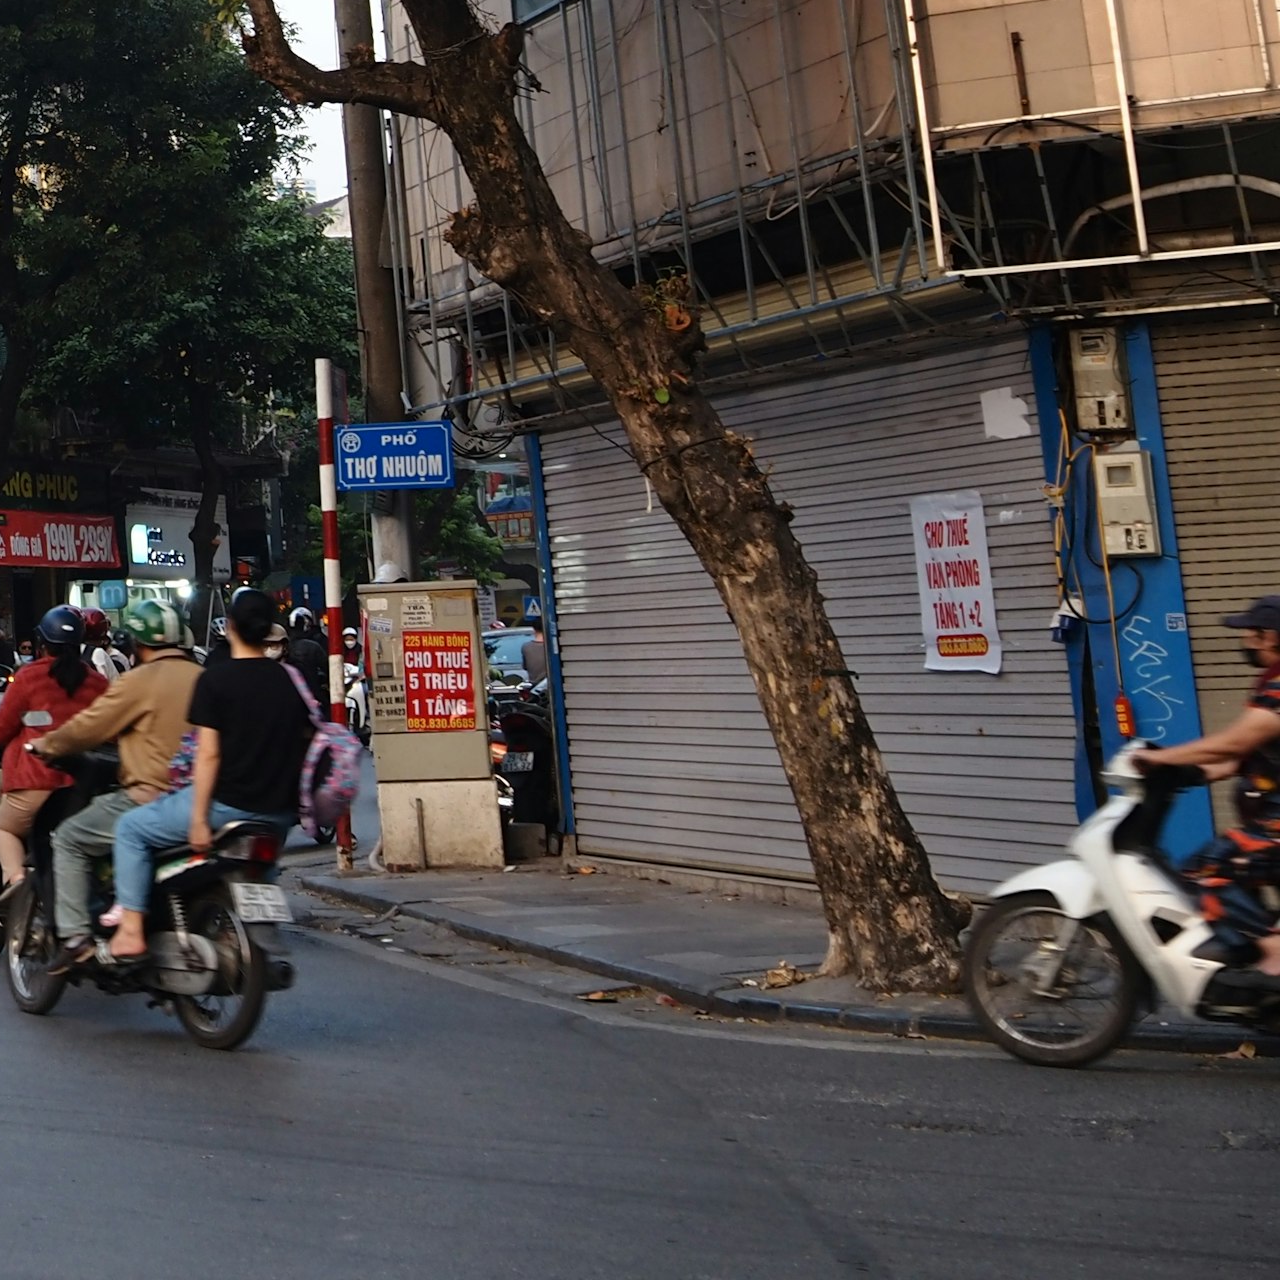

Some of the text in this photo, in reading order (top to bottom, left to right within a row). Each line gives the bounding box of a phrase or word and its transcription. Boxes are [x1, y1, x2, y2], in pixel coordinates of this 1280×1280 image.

[381, 429, 418, 446] PHỐ
[345, 450, 443, 483] THỢ NHUỘM
[43, 522, 116, 563] 199K-299K
[924, 520, 945, 549] CHO
[945, 553, 980, 589] PHÒNG
[958, 601, 967, 629] 1
[405, 633, 470, 647] 225 HÀNG BÔNG
[405, 648, 470, 668] CHO THUÊ
[409, 669, 468, 693] 5 TRIỆU
[412, 693, 467, 716] 1 TẦNG
[407, 717, 475, 729] 083.830.6685
